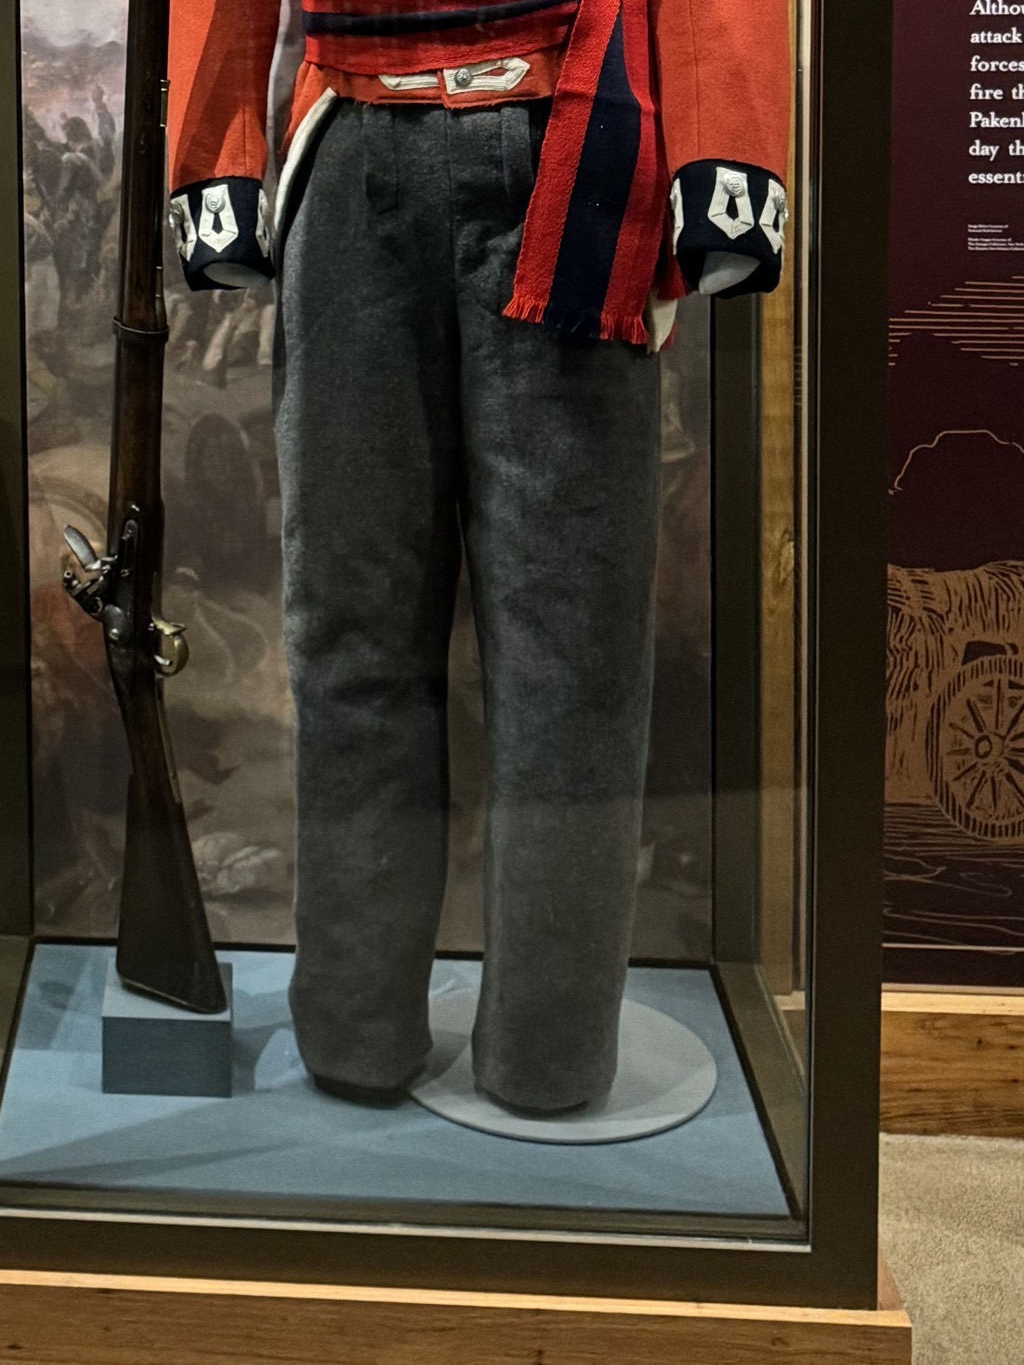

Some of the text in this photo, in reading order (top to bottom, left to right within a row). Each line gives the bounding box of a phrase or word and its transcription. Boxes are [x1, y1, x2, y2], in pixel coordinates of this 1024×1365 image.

[970, 27, 1022, 44] attack
[969, 83, 1004, 100] fire
[969, 140, 1000, 161] day
[968, 172, 1024, 184] essent
